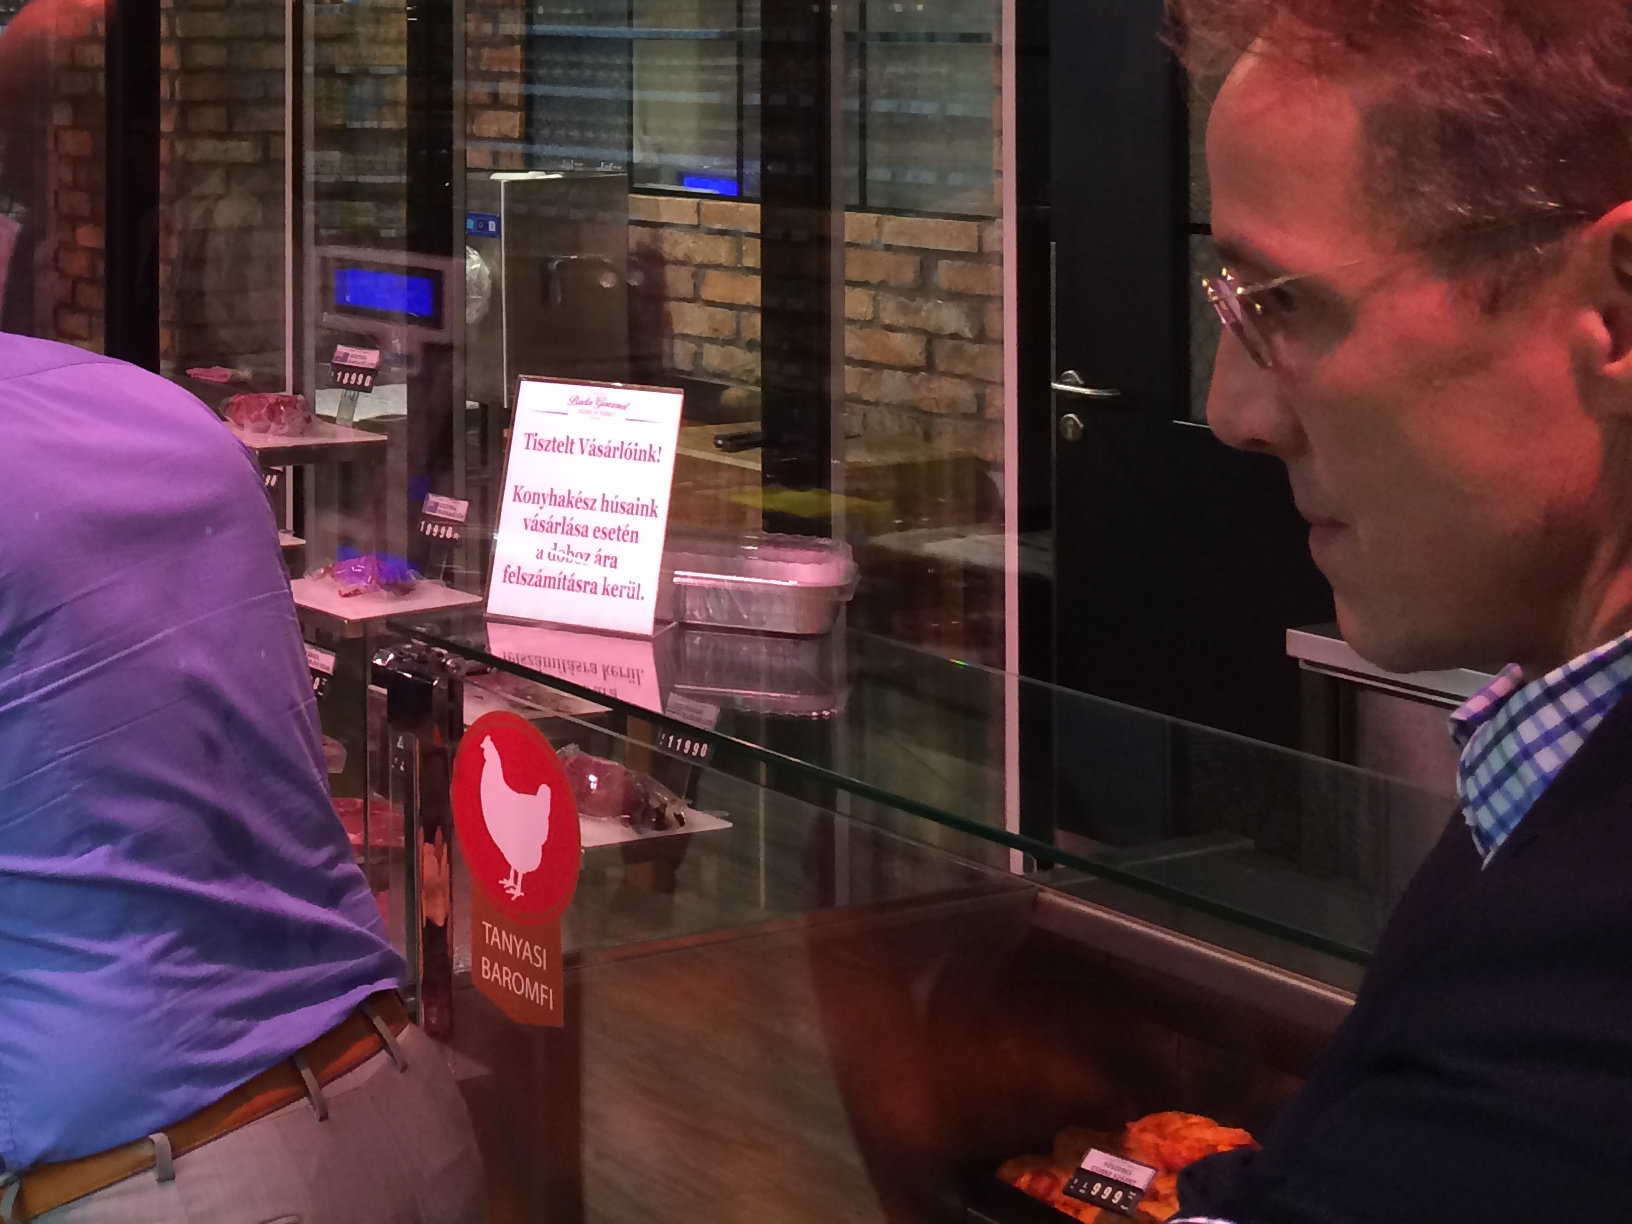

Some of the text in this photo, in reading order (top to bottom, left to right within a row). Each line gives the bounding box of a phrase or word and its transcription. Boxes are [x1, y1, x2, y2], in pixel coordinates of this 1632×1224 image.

[524, 432, 662, 463] Tisztelt Vásárlóink!
[511, 484, 659, 518] Konyhakész húsaink
[523, 512, 639, 544] vásárlása esetén
[535, 542, 618, 570] a doboz ára
[501, 564, 645, 601] felszámításra kerül.
[481, 920, 547, 971] TANYASI
[481, 956, 554, 1010] BAROMFI
[1090, 1182, 1124, 1204] 999
